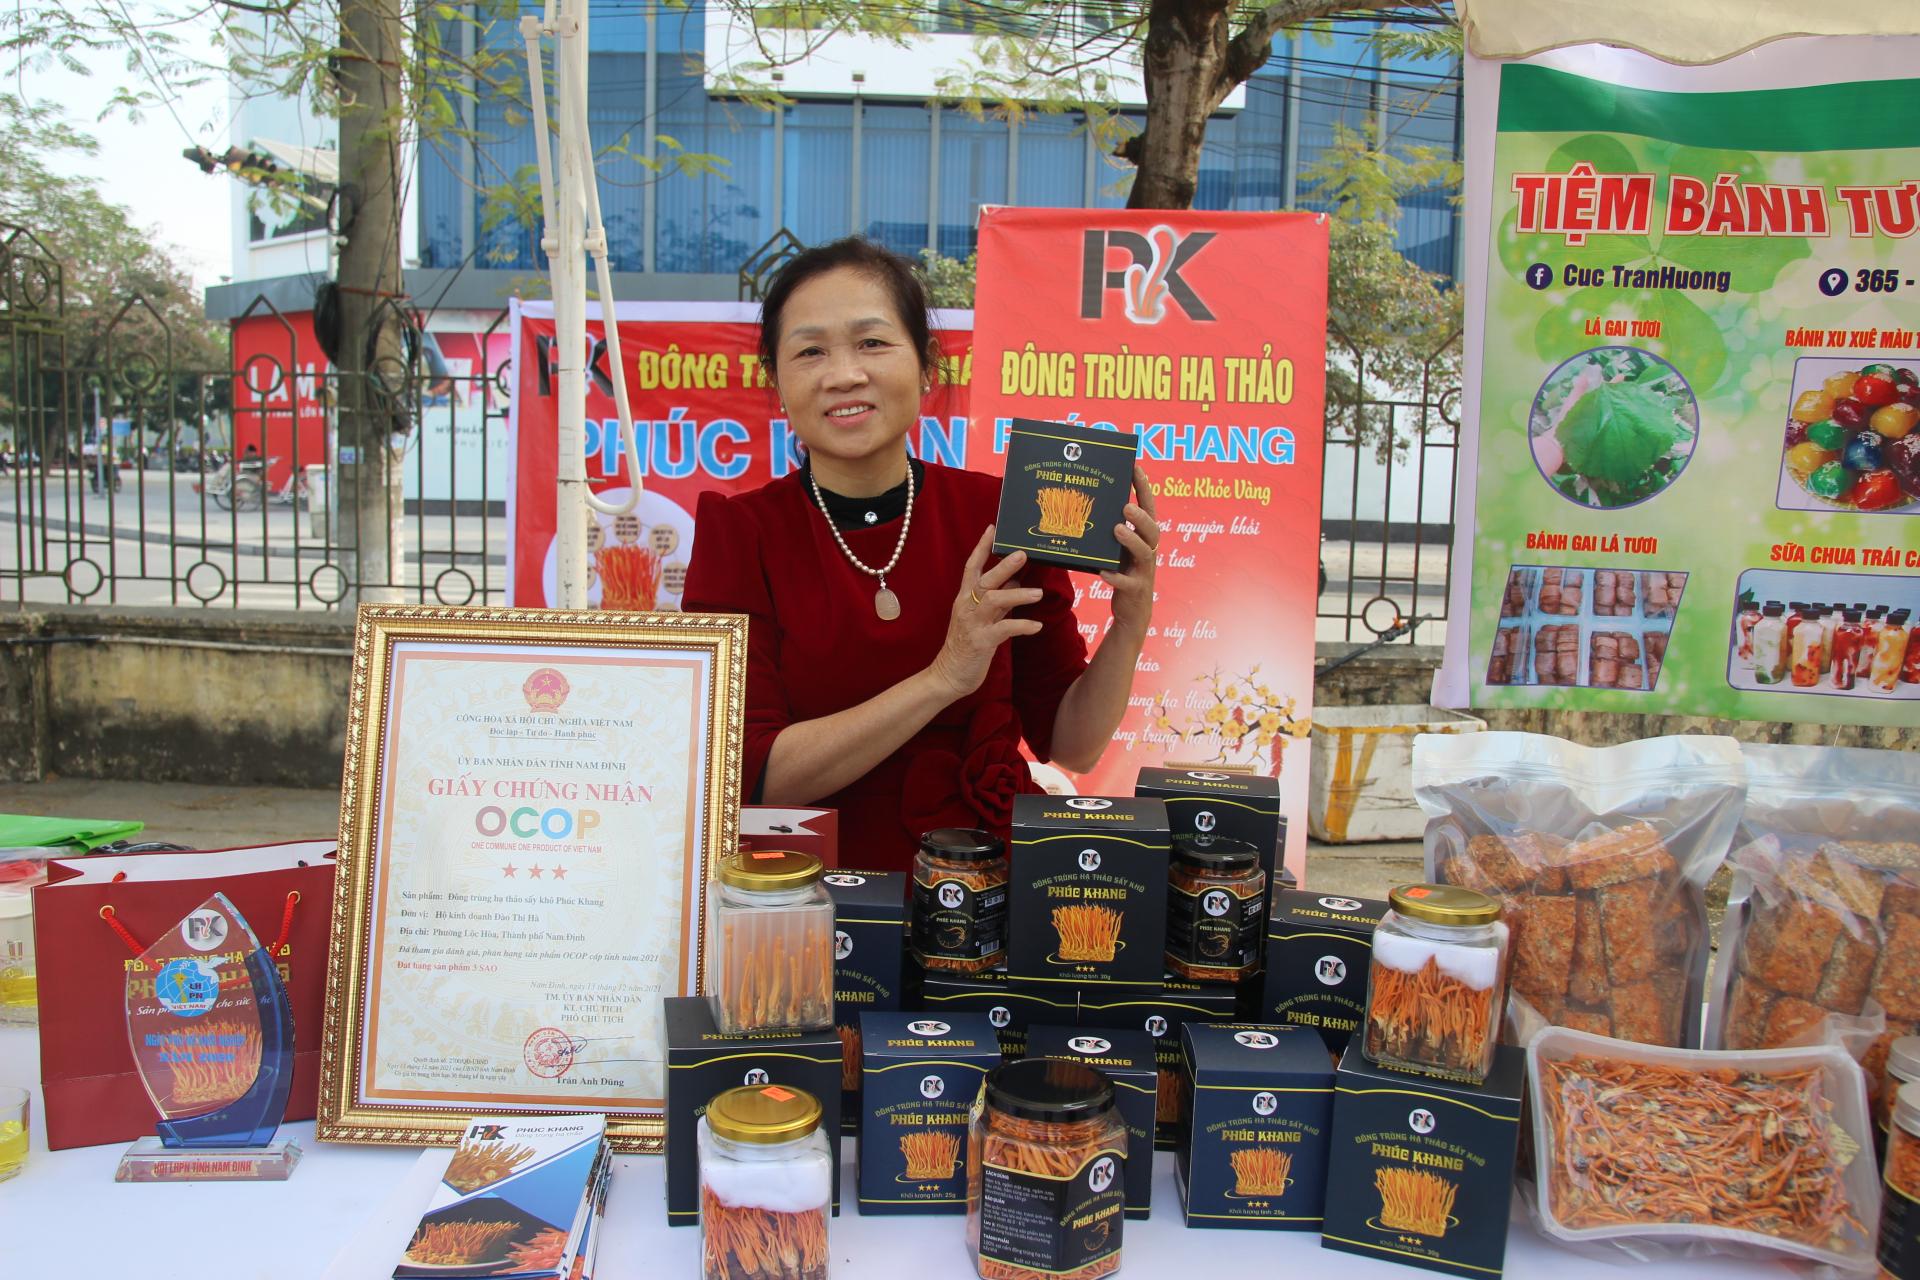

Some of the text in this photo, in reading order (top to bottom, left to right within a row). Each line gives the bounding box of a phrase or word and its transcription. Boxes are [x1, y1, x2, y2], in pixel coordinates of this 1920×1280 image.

[1511, 160, 1920, 248] TIỆM BÁNH TƯ
[1563, 263, 1731, 292] Cuc TranHuong
[1855, 269, 1899, 292] 365
[1584, 318, 1660, 338] LÁ GAI TƯƠI
[1785, 328, 1823, 347] BÁNH
[1825, 331, 1847, 348] XU
[1849, 329, 1878, 348] XUÊ
[1881, 329, 1912, 349] MÀU
[638, 343, 729, 389] ĐÔNG
[1000, 341, 1076, 398] ĐÔNG
[1083, 343, 1173, 401] TRÙNG
[1179, 355, 1217, 413] HẠ
[1223, 342, 1295, 405] THẢO
[1132, 421, 1296, 465] KHANG
[1035, 469, 1100, 488] PHÚC KHANG
[1164, 476, 1271, 506] Sức Khỏe Vàng
[1526, 529, 1657, 554] BÁNH GAI LÁ TƯƠI
[1770, 543, 1805, 562] SỮA
[1811, 546, 1855, 564] CHUA
[1862, 545, 1900, 567] TRÁI
[474, 757, 492, 766] BAN
[576, 760, 598, 769] NAM
[428, 772, 654, 806] GIẤY CHỨNG NHẬN
[475, 805, 601, 840] OCOP
[1085, 813, 1135, 821] KHANG
[1048, 885, 1127, 900] PHÚC KHANG
[449, 912, 466, 920] kinh
[468, 912, 492, 921] doanh
[1331, 913, 1380, 925] KHANG
[137, 1004, 155, 1015] Sản
[216, 998, 233, 1008] cho
[1323, 1017, 1359, 1031] KHAN
[1083, 1057, 1132, 1066] KHANG
[580, 1077, 598, 1086] Anh
[601, 1077, 624, 1087] Dũng
[890, 1112, 969, 1125] PHÚC KHANG
[1221, 1129, 1301, 1143] PHÚC KHANG
[1371, 1142, 1464, 1171] PHÚC KHANG
[1095, 1203, 1120, 1222] KHANG
